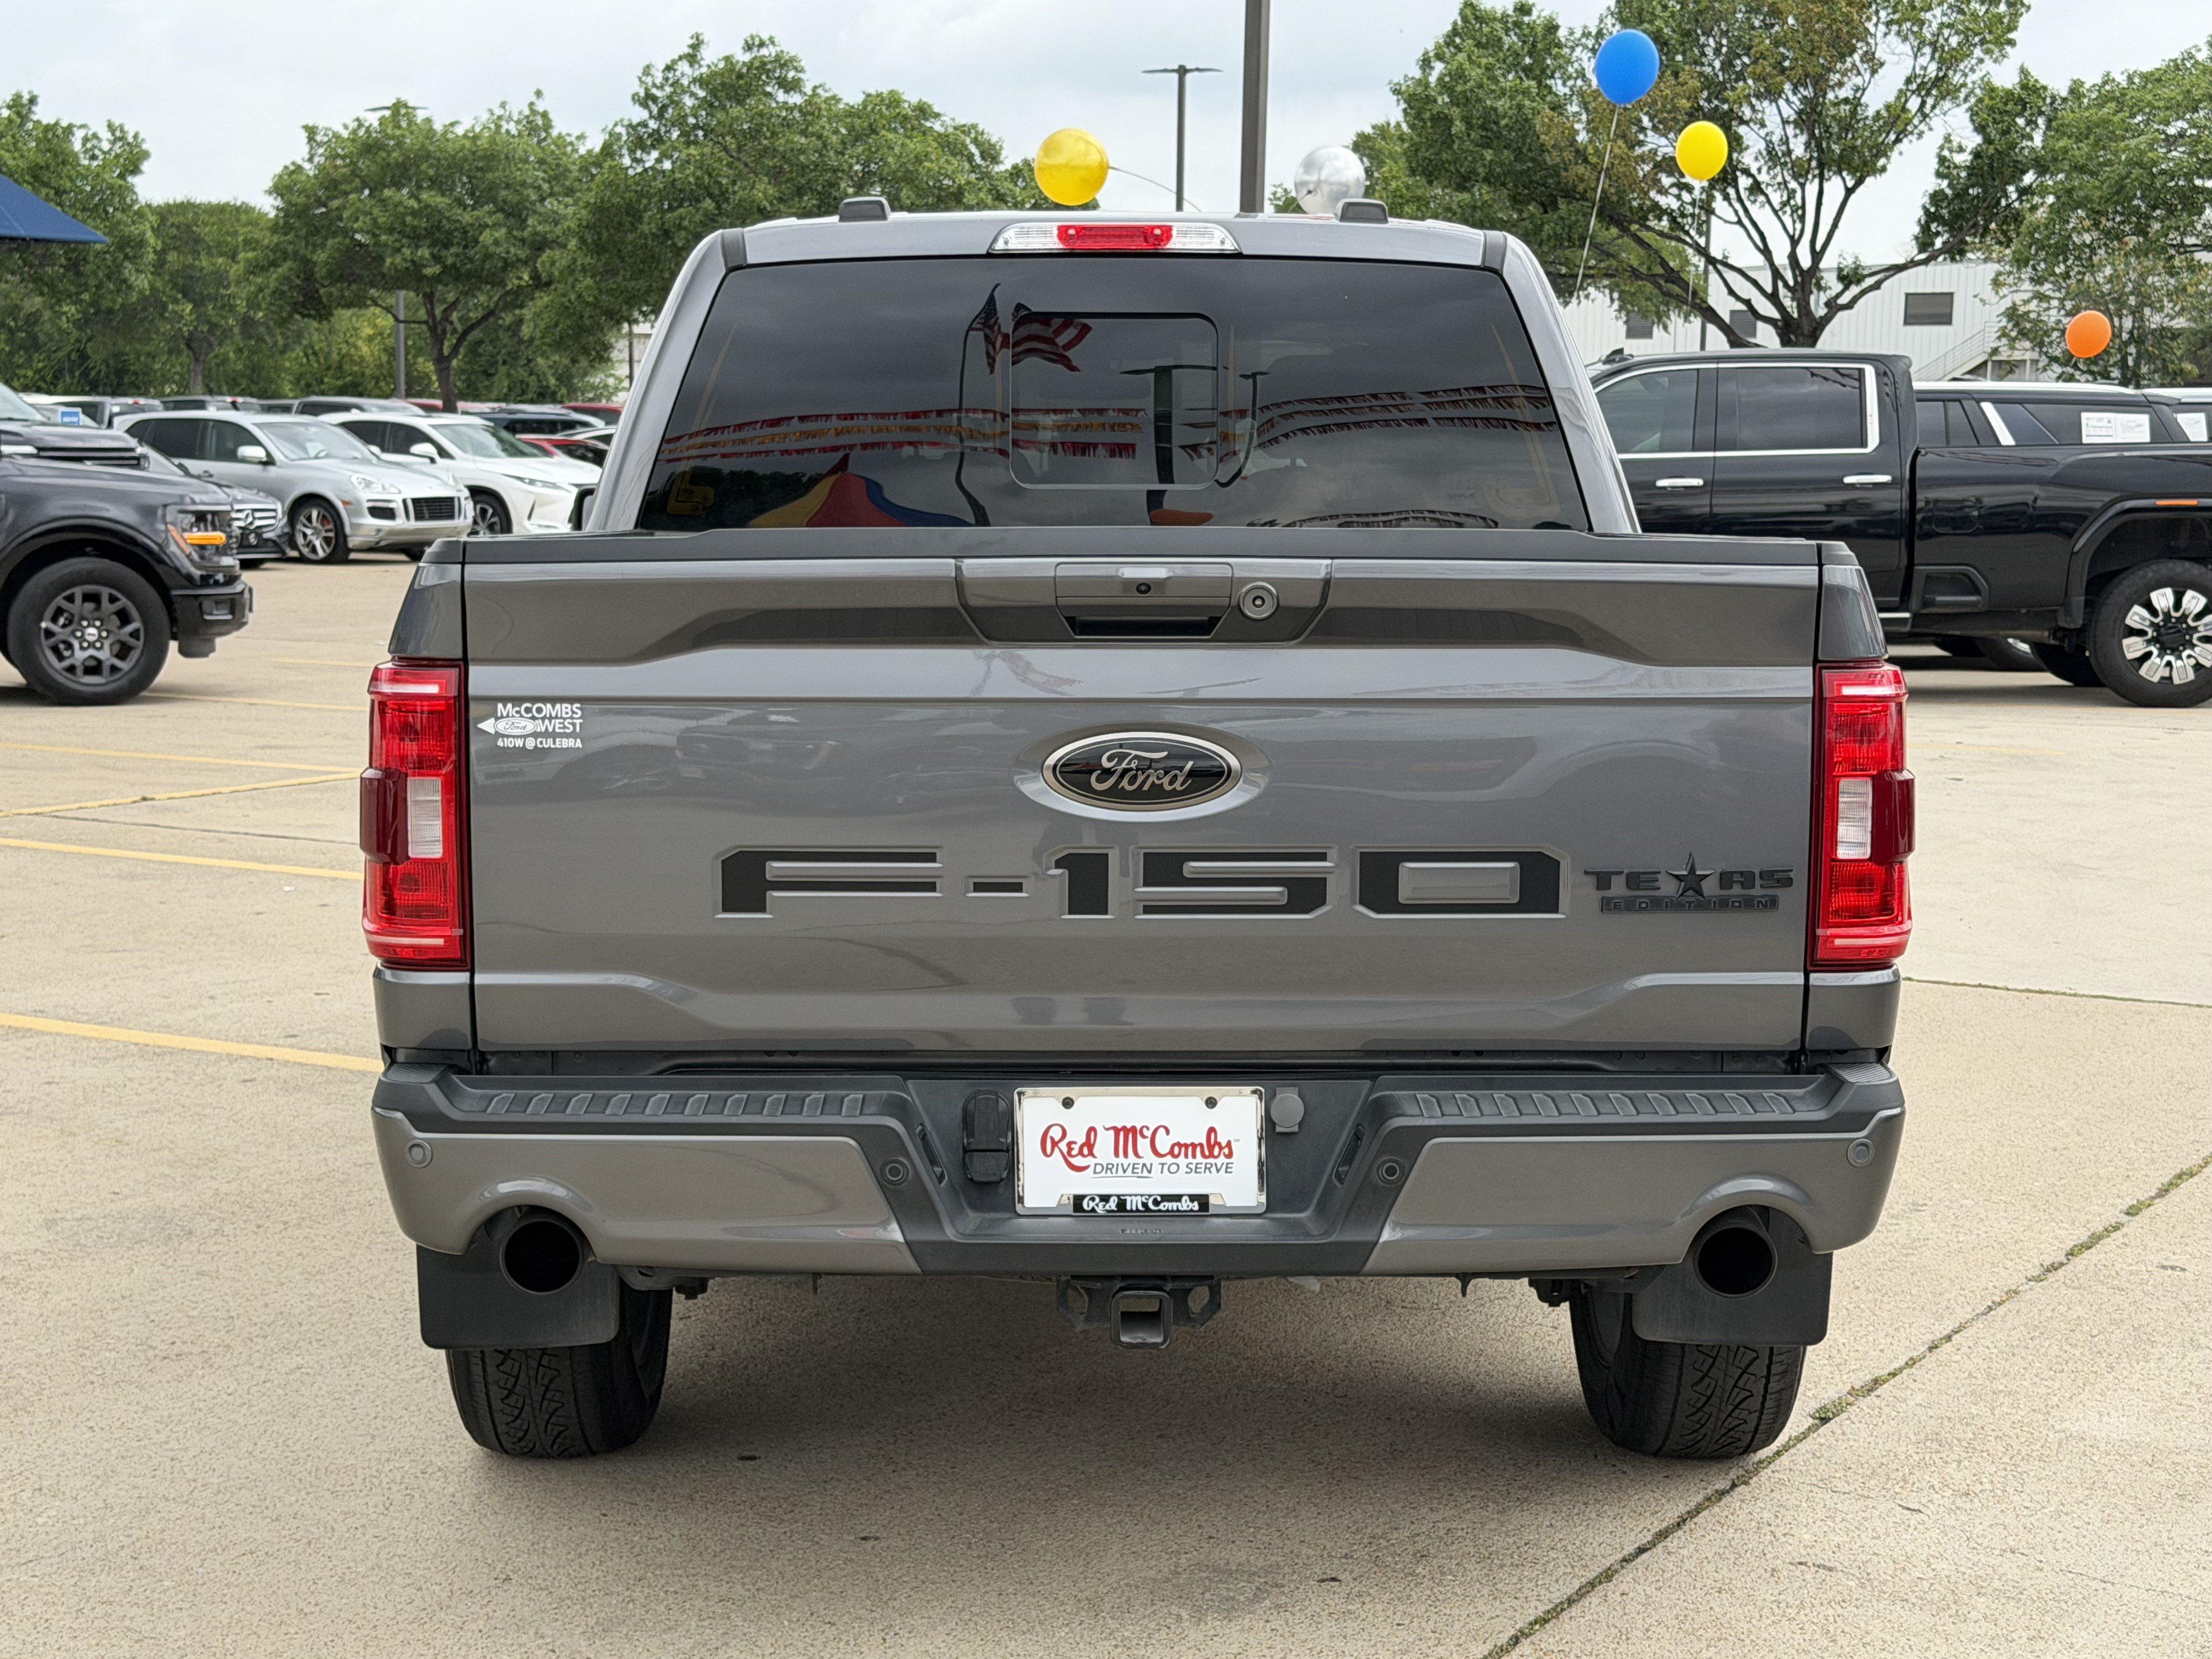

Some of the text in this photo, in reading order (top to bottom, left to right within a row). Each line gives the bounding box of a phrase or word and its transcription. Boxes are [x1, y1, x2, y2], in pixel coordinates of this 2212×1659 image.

[497, 703, 582, 718] McCOMBS
[503, 721, 527, 731] Ford
[538, 719, 583, 732] WEST
[1091, 749, 1194, 791] Ford
[715, 845, 1570, 918] F-150
[1611, 899, 1769, 910] EDITION
[1040, 1123, 1098, 1172] Red
[1103, 1124, 1234, 1160] McCombs
[1093, 1163, 1234, 1175] DRIVEN TO SERVE
[1082, 1194, 1199, 1214] Red McCombs
